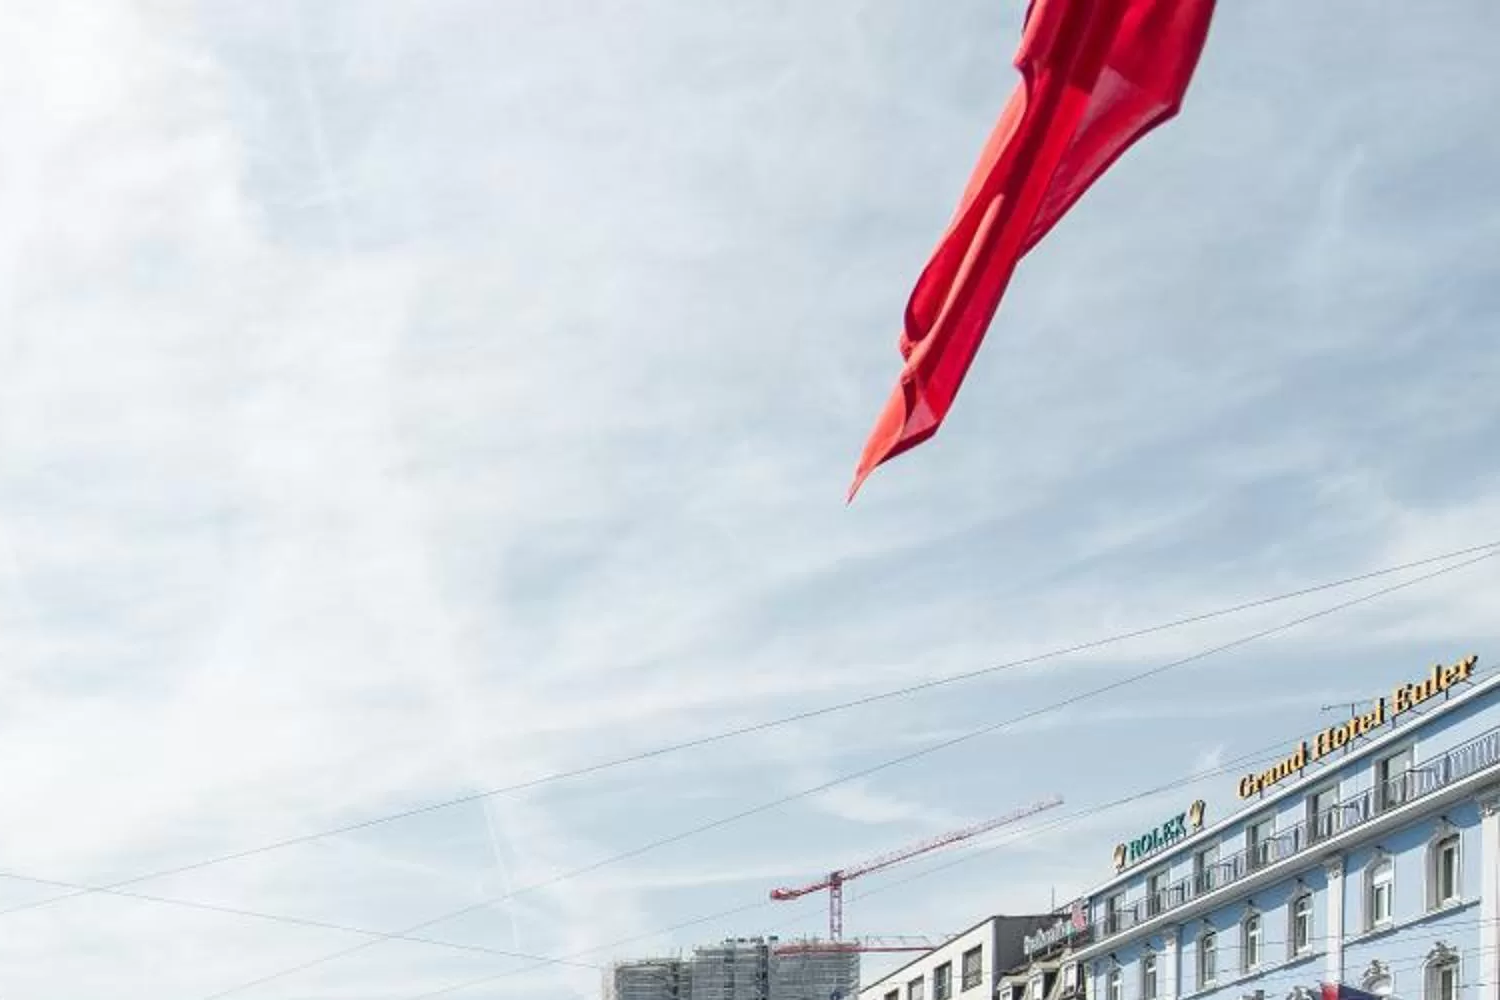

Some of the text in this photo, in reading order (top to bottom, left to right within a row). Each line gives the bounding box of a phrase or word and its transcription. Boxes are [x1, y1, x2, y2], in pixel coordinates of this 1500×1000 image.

[1238, 655, 1479, 799] Grand Hotel Euler
[1128, 812, 1187, 860] ROLEX
